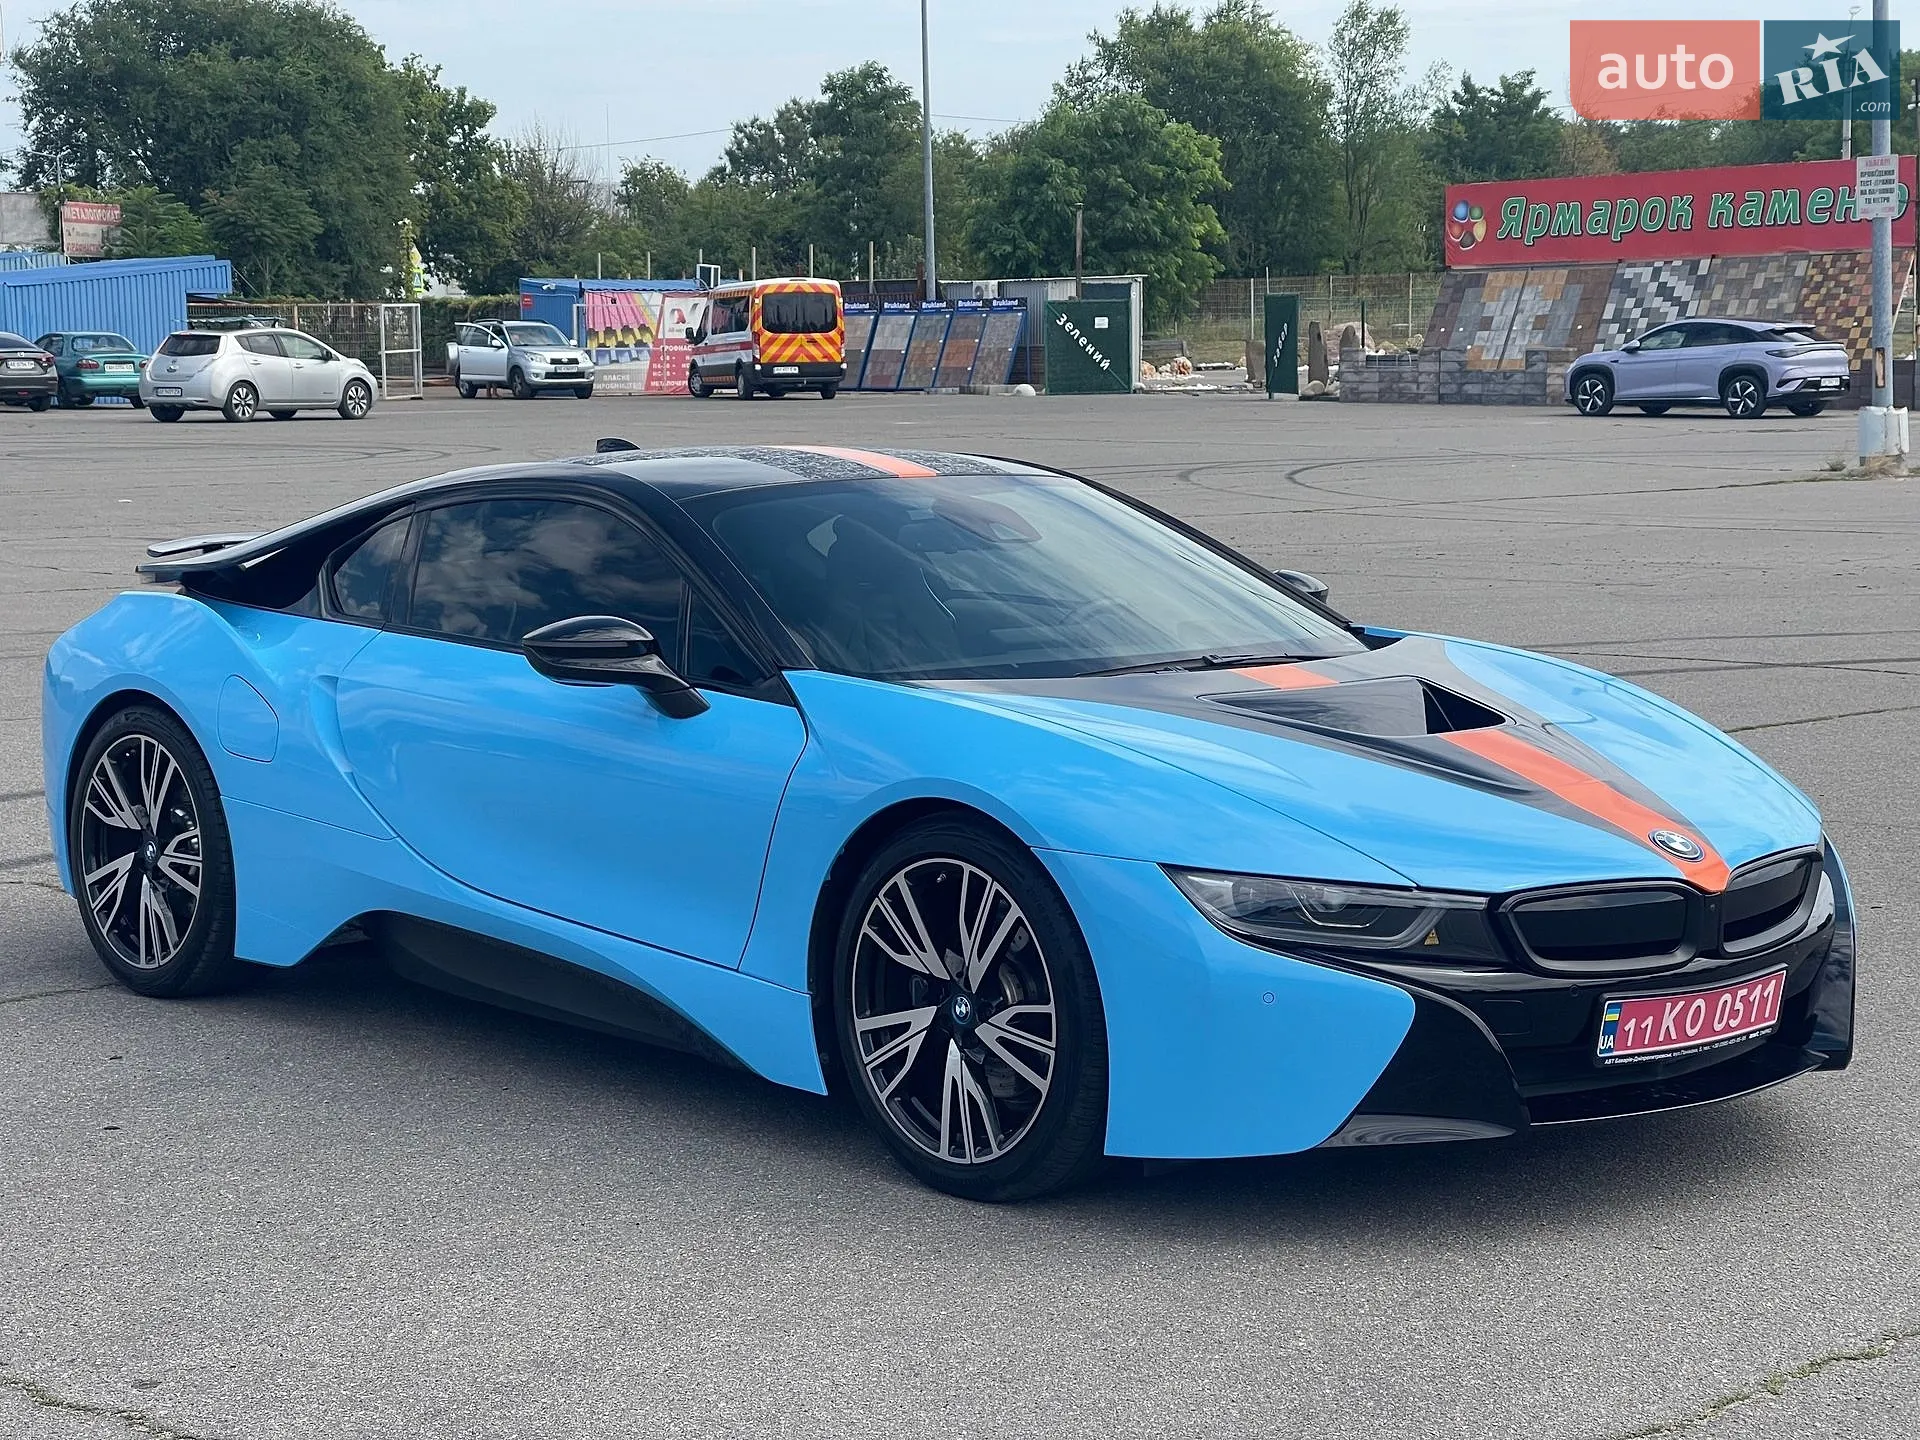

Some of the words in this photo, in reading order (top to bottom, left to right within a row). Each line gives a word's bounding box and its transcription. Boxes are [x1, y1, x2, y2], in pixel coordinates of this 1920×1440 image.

[1497, 193, 1693, 246] Ярмарок
[1708, 182, 1909, 229] камен
[922, 301, 946, 309] Brukland
[958, 300, 982, 308] Brukland
[992, 299, 1018, 307] Brukland
[1056, 313, 1111, 371] Зелений
[1273, 322, 1288, 368] Забор
[1713, 979, 1777, 1032] 0511
[1600, 1035, 1614, 1049] UA
